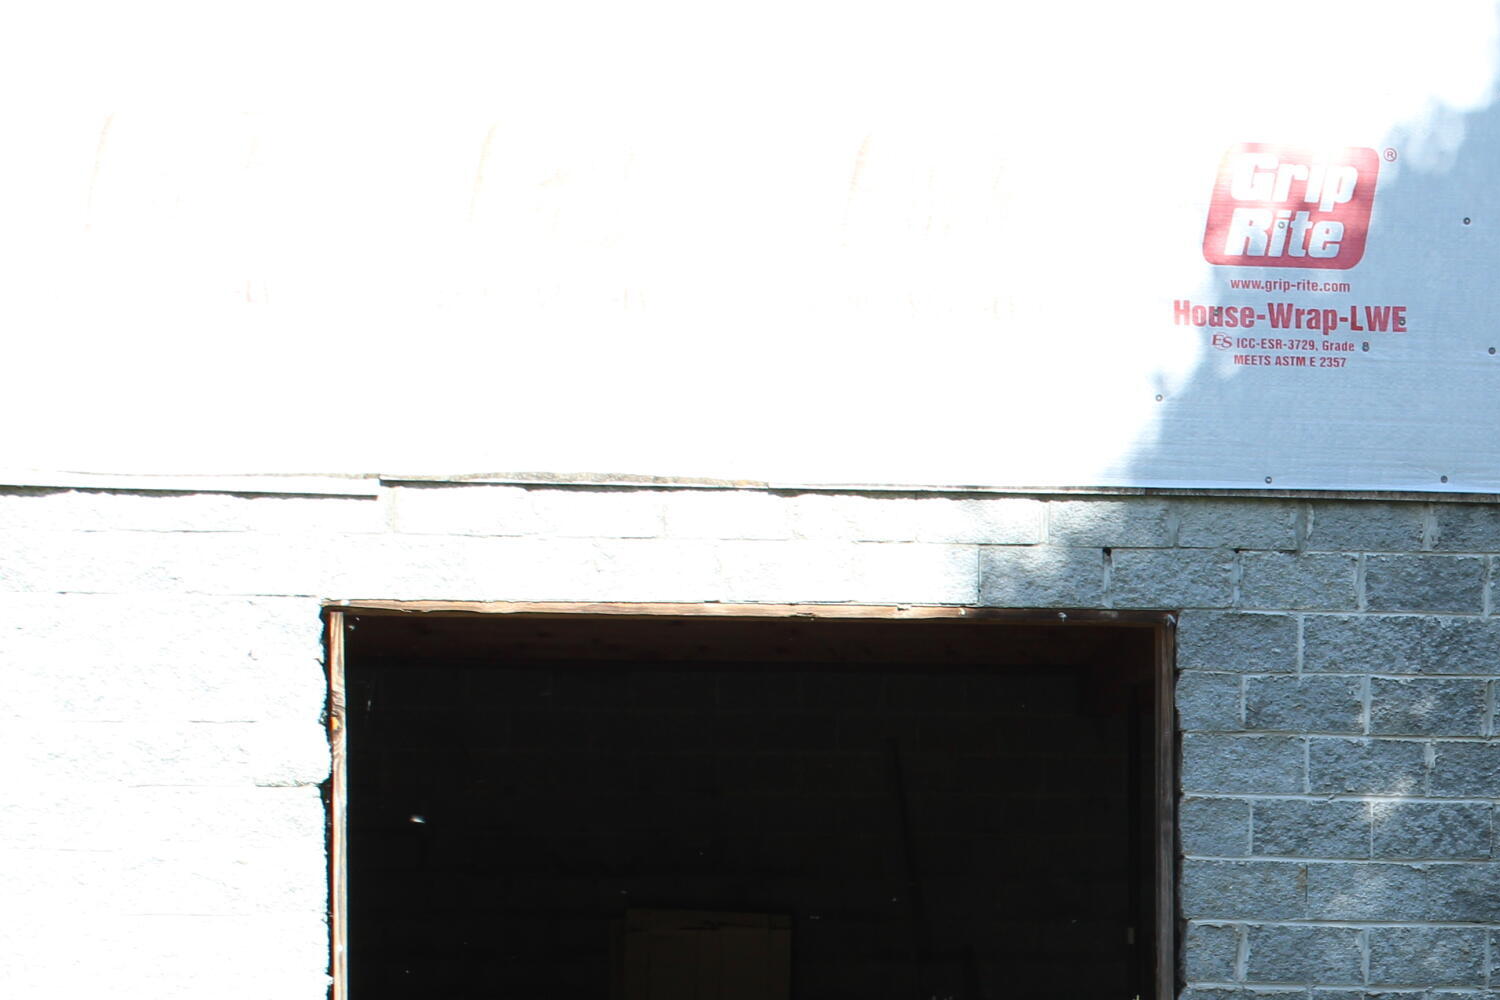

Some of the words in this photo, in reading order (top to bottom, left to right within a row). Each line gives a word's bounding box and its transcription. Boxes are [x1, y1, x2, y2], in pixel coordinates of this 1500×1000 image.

[1231, 154, 1359, 212] Grip
[1223, 207, 1344, 258] Rite
[1230, 279, 1351, 293] www.grip-rite.com
[1173, 300, 1407, 336] House-Wrap-LWE
[1322, 340, 1355, 352] Grade
[1233, 354, 1271, 366] MEETS
[1275, 355, 1306, 367] ASTM
[1309, 356, 1317, 367] E
[1319, 357, 1347, 368] 2357
